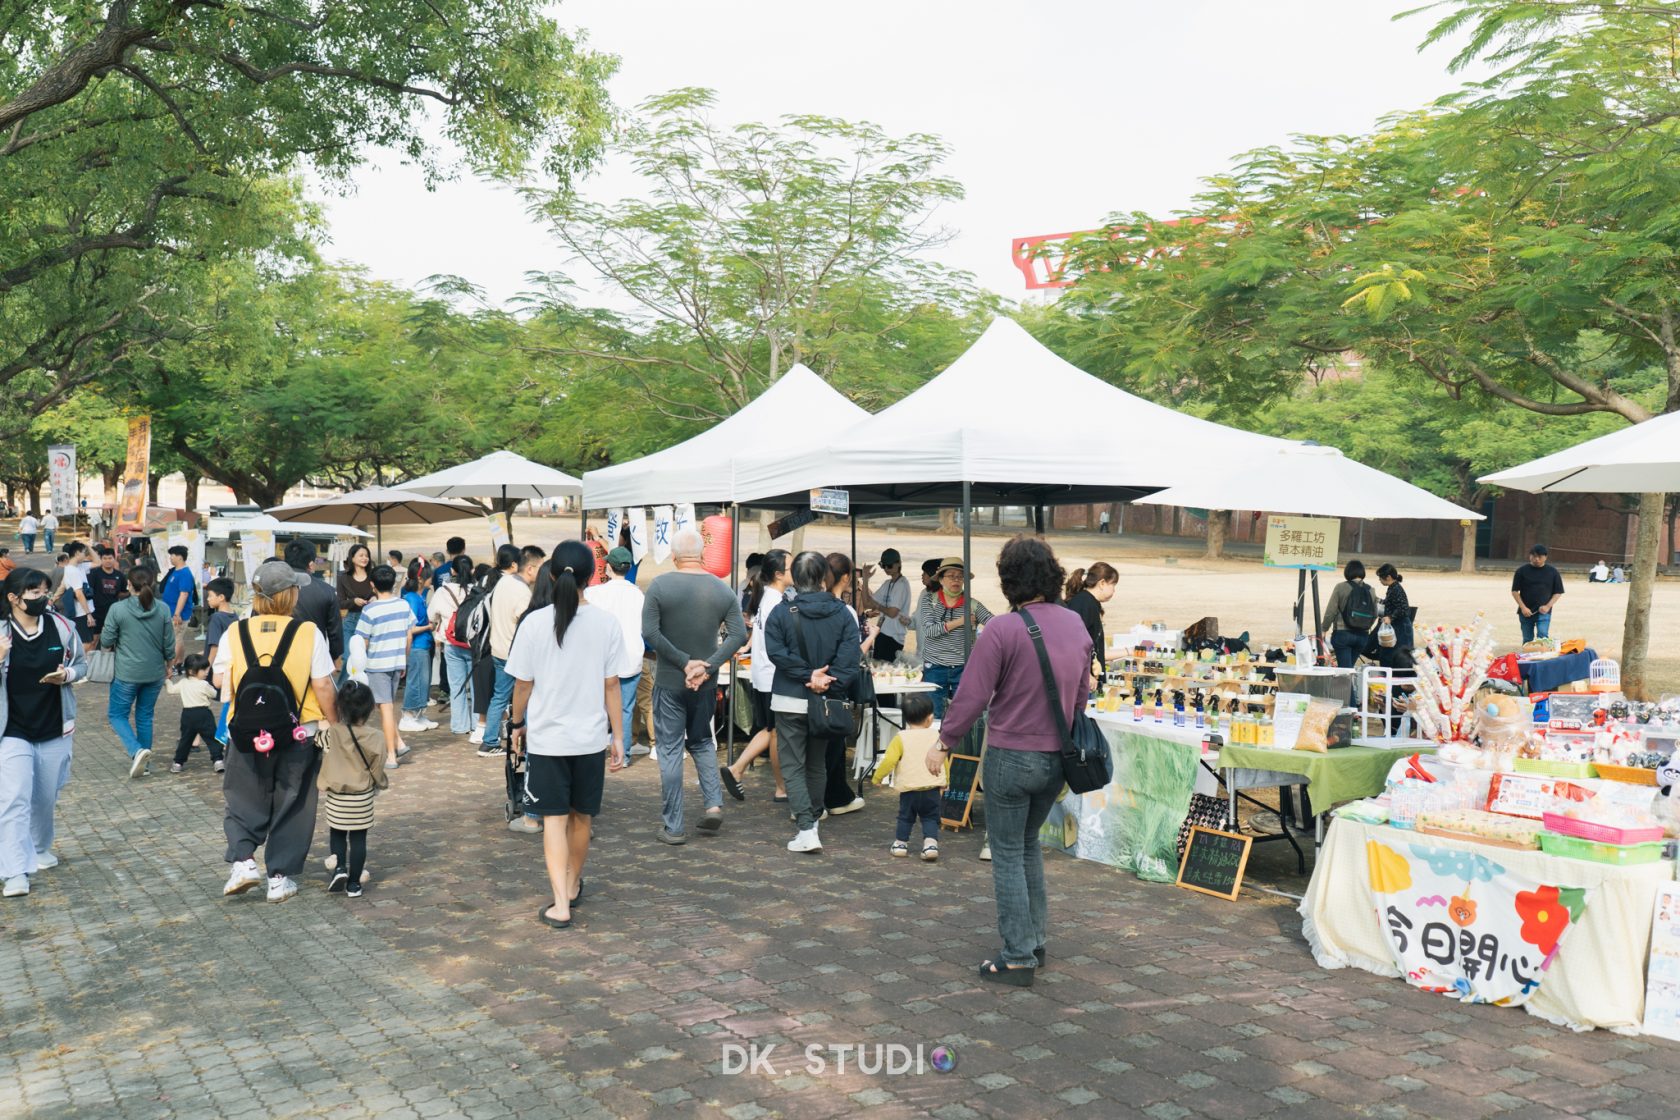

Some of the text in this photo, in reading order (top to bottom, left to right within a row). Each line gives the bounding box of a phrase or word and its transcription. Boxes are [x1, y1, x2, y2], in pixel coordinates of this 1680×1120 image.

[1280, 530, 1326, 544] 多羅工坊
[1278, 544, 1324, 558] 草本精油
[1387, 905, 1539, 985] 今日開心
